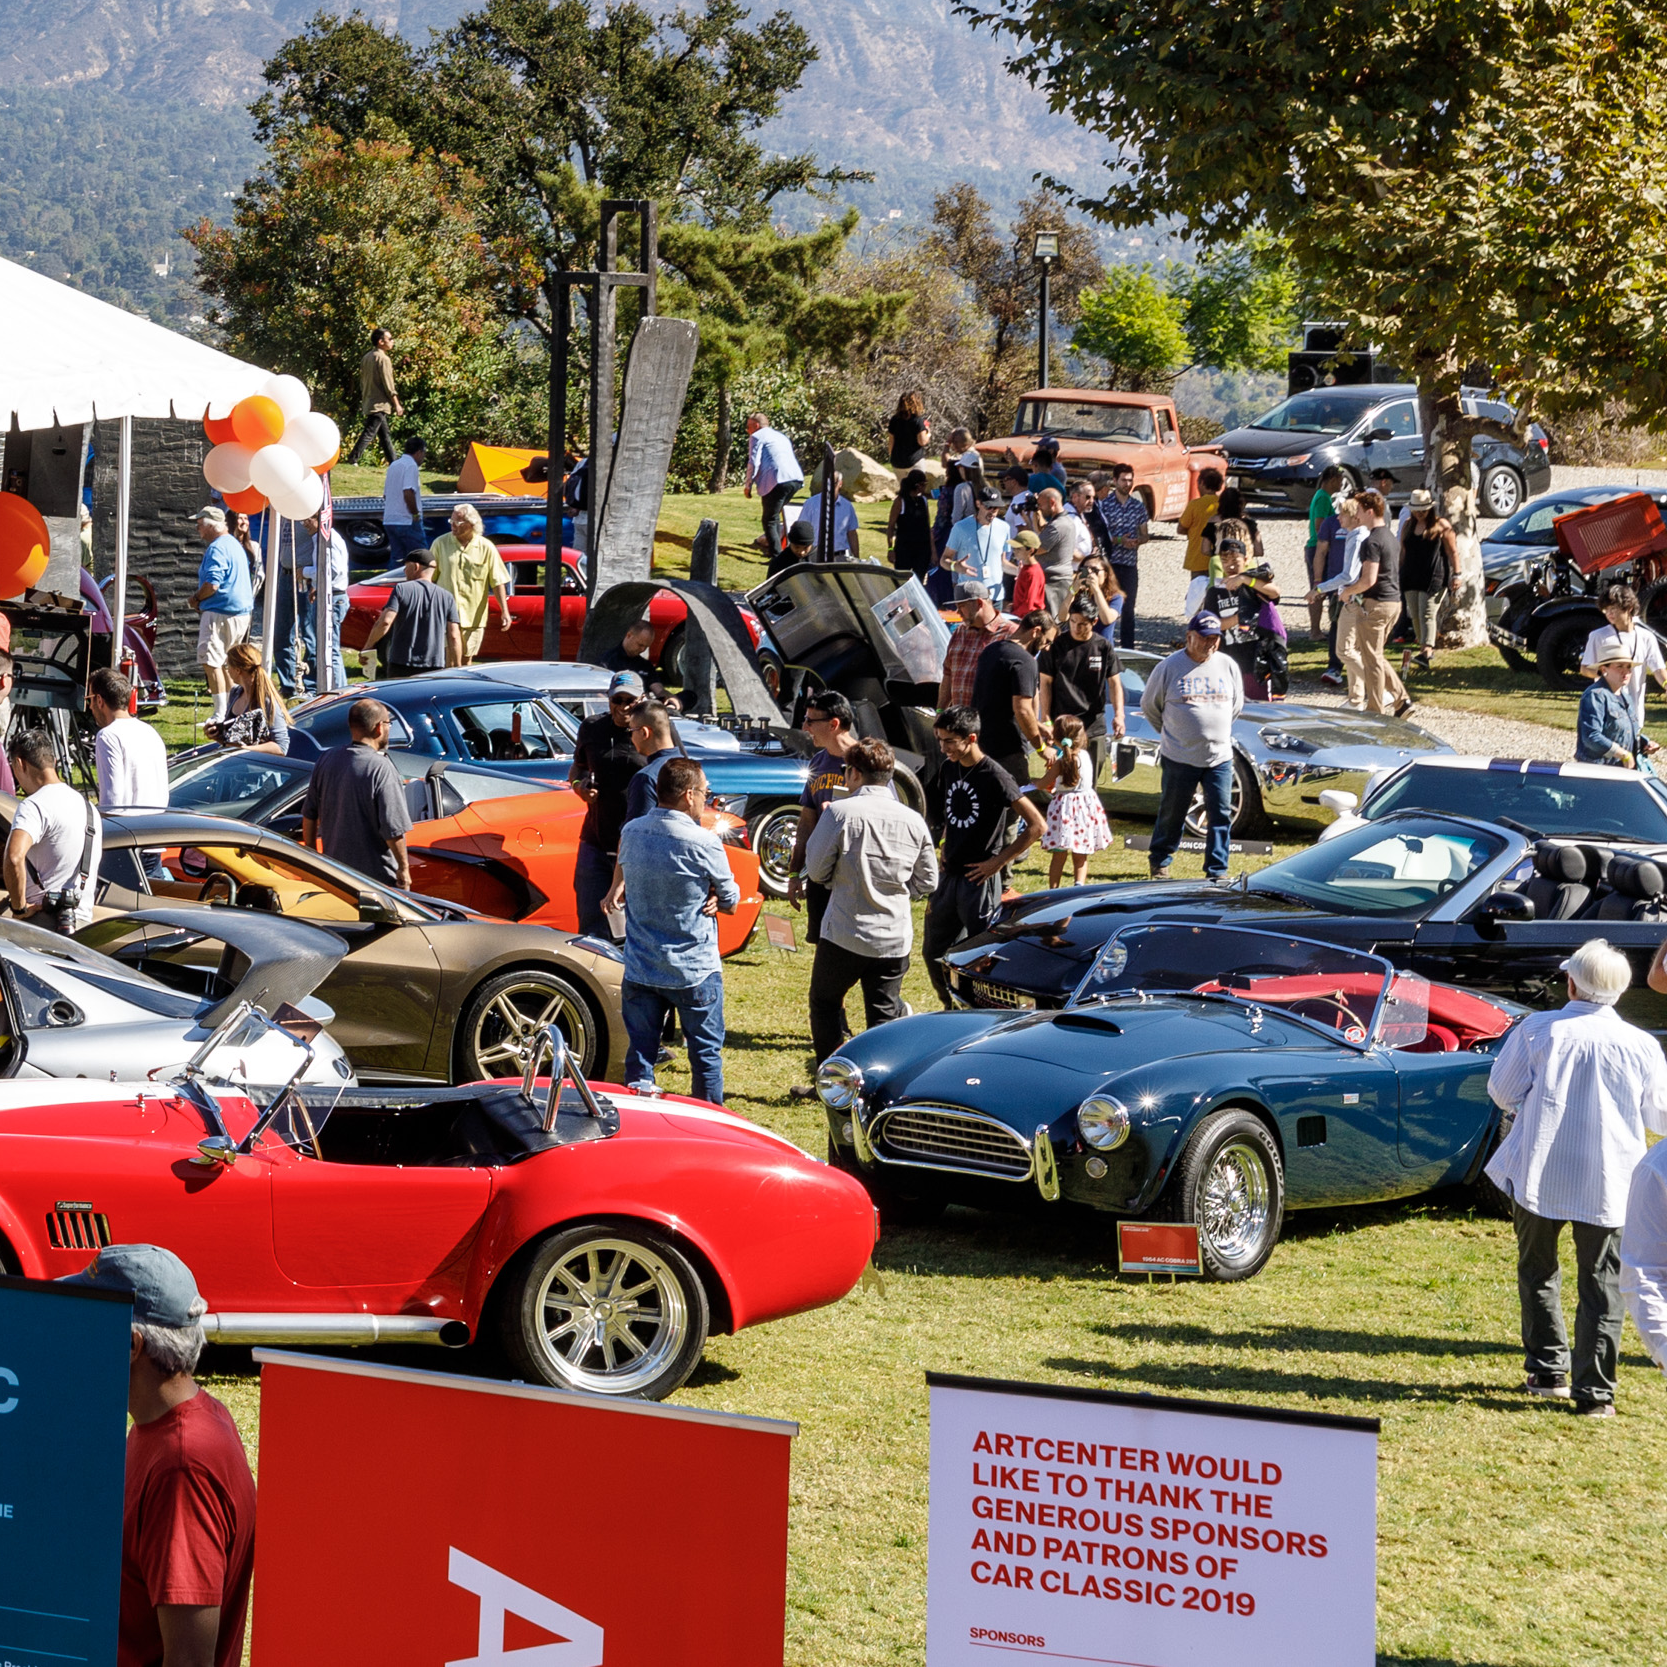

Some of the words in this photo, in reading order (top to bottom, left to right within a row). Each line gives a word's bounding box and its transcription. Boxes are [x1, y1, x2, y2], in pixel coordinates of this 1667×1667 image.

[1218, 597, 1230, 608] THE
[1177, 677, 1227, 694] UCLA
[973, 1430, 1160, 1472] ARTCENTER
[1166, 1451, 1282, 1485] WOULD
[972, 1463, 1040, 1493] LIKE
[1046, 1470, 1088, 1498] TO
[1094, 1477, 1204, 1510] THANK
[1209, 1488, 1273, 1519] THE
[971, 1495, 1143, 1536] GENEROUS
[1150, 1516, 1328, 1558] SPONSORS
[971, 1528, 1037, 1557] AND
[1043, 1536, 1189, 1575] PATRONS
[1195, 1555, 1239, 1580] OF
[970, 1560, 1034, 1590] CAR
[1040, 1569, 1175, 1606] CLASSIC
[1182, 1586, 1256, 1617] 2019
[969, 1627, 1045, 1648] SPONSORS
